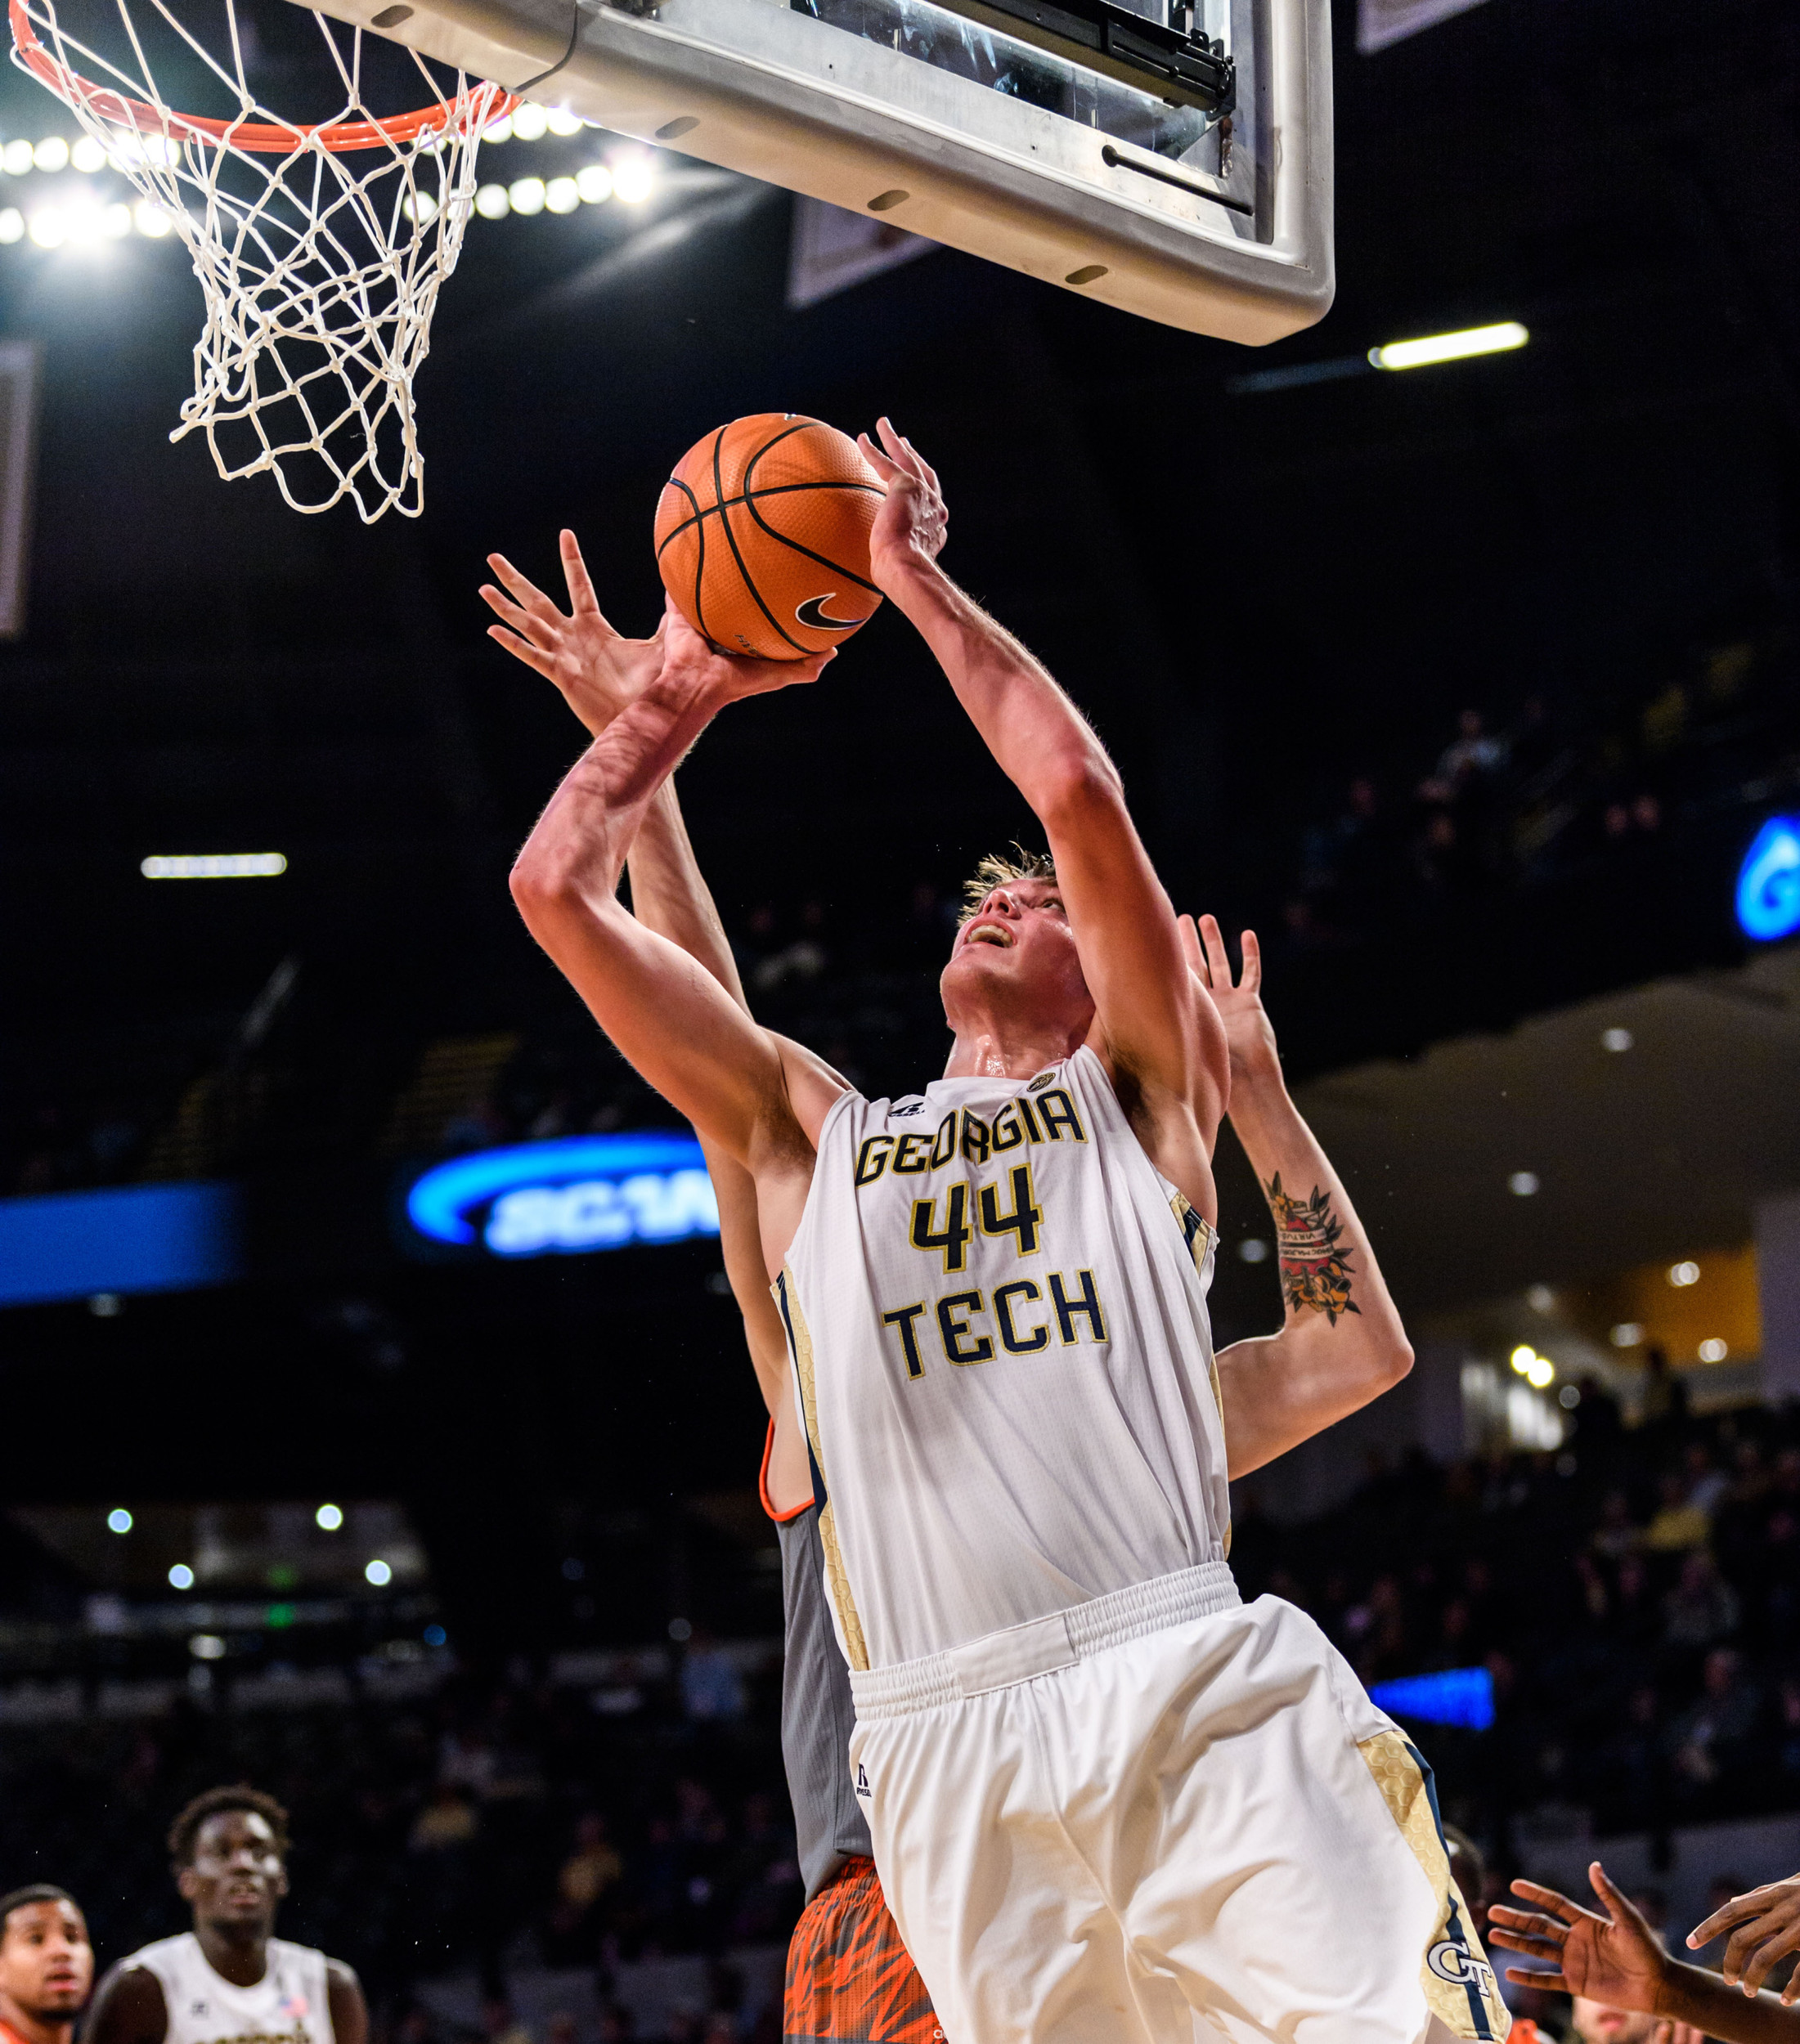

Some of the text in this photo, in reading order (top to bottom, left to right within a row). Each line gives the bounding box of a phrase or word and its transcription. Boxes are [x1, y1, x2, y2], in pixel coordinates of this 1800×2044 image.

[854, 1088, 1087, 1188] GEORGIA
[909, 1163, 1044, 1275] 44
[882, 1269, 1109, 1380] TECH
[1427, 1940, 1492, 1997] GT
